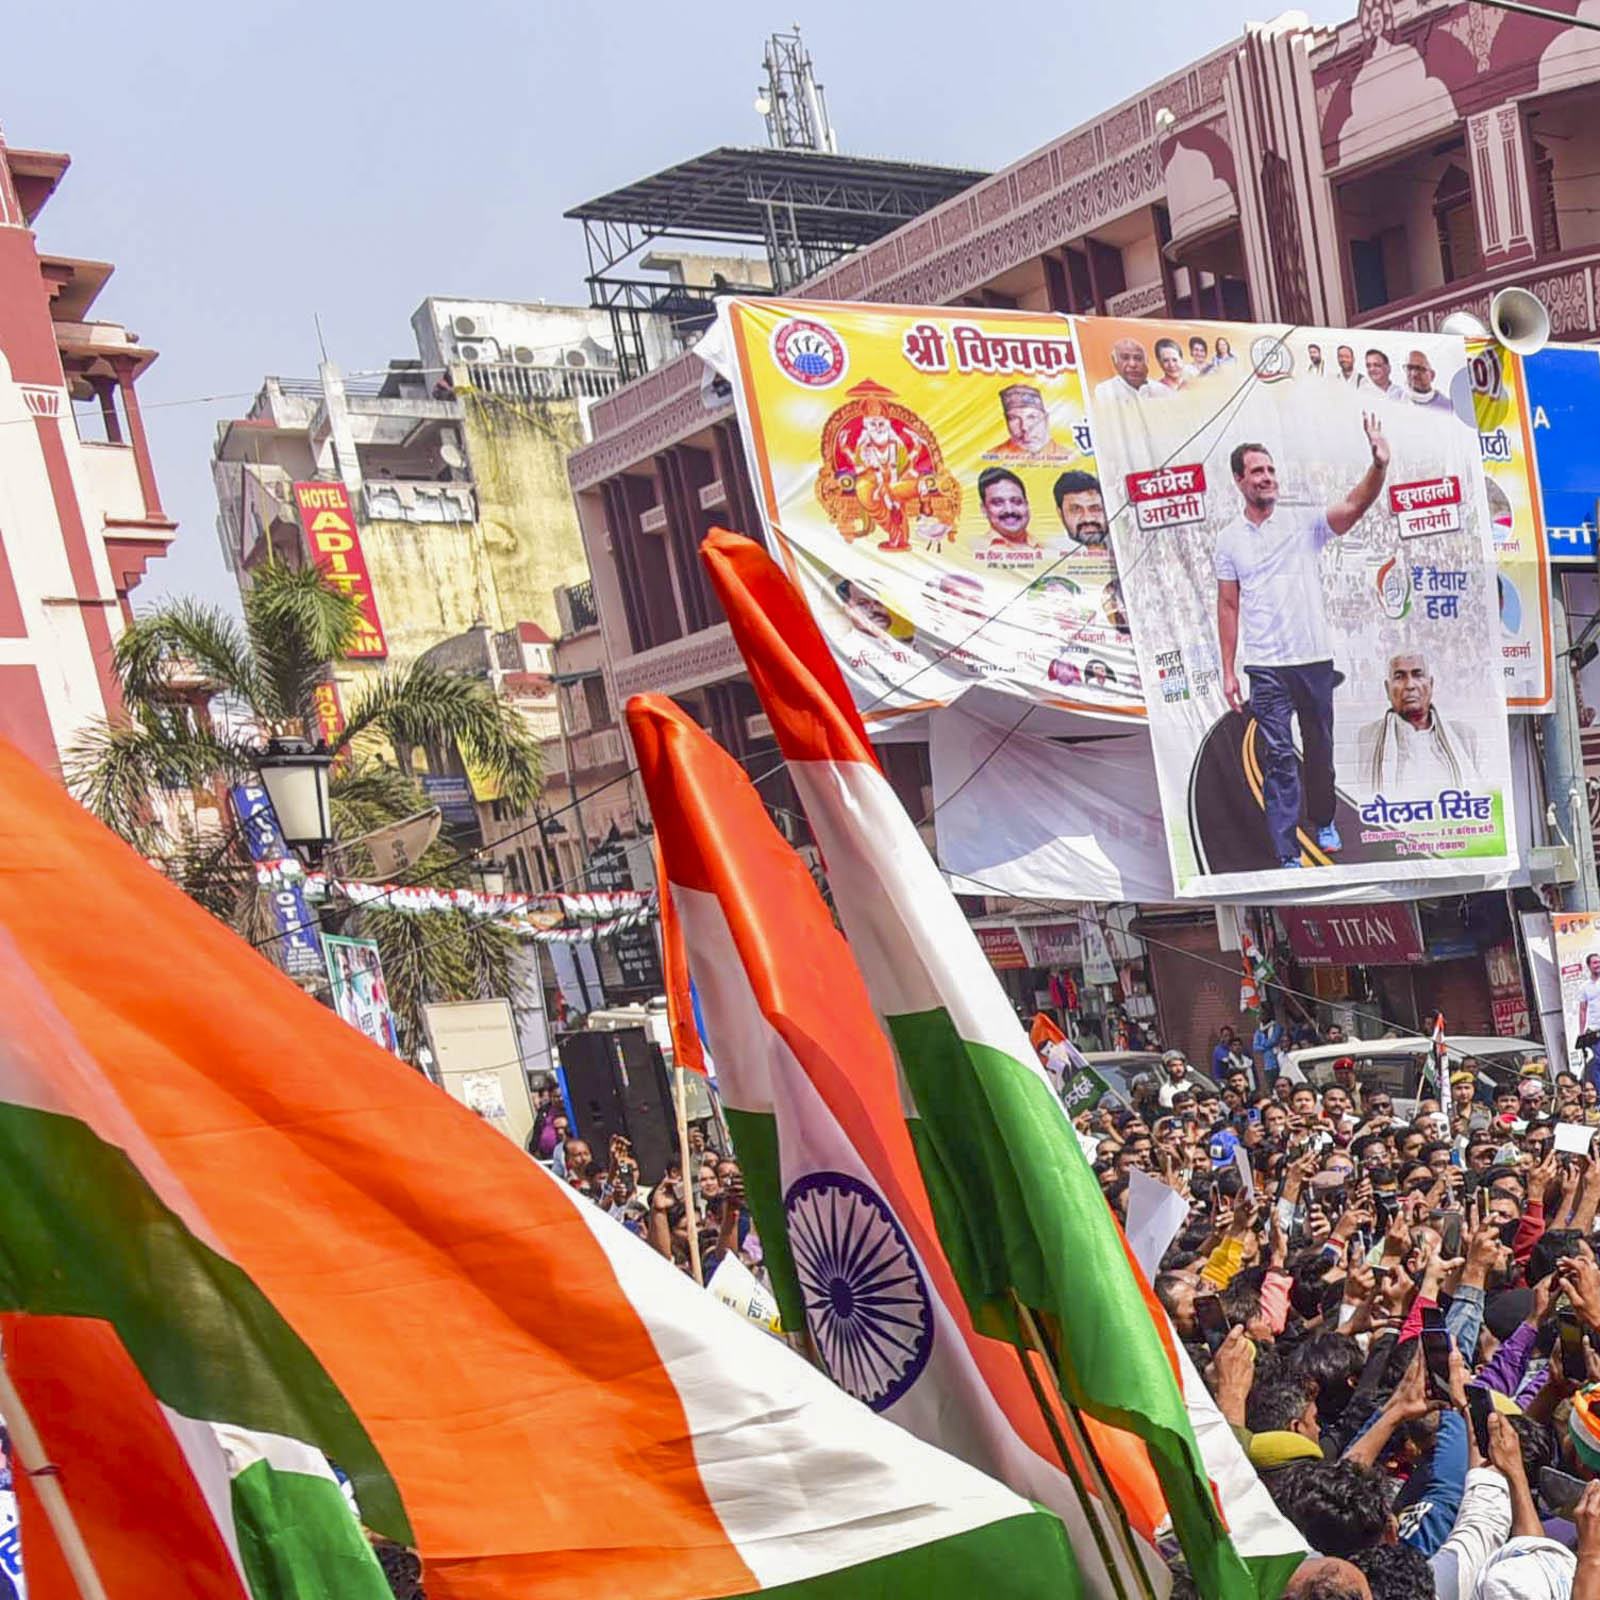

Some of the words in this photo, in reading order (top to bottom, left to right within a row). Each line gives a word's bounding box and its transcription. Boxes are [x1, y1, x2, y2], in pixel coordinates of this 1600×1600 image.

[903, 325, 948, 369] श्री
[953, 327, 1078, 371] विश्वक
[1136, 470, 1195, 496] कांग्रेस
[1394, 481, 1456, 509] खुशहाली
[299, 487, 347, 509] HOTEL
[1141, 498, 1201, 525] आयेगी
[1408, 510, 1452, 533] लायेगी
[1428, 567, 1468, 591] तैयार
[1424, 594, 1460, 620] हम
[1361, 793, 1433, 824] दौलत
[1439, 789, 1491, 820] सिंह
[1327, 918, 1397, 947] TITAN
